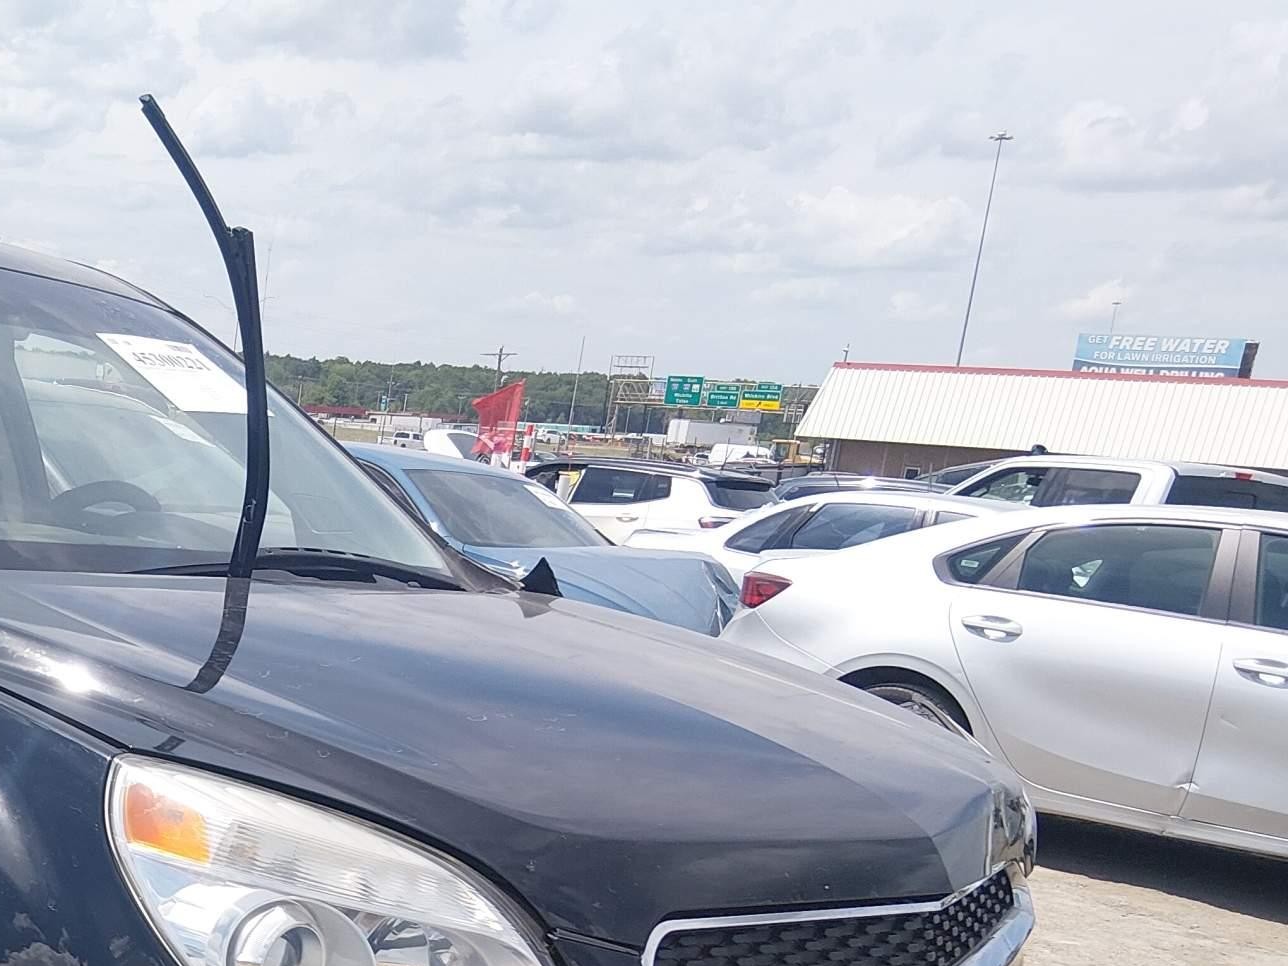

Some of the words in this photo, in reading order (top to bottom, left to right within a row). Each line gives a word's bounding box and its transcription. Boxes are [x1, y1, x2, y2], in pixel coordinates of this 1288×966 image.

[1088, 335, 1109, 344] GET
[1108, 336, 1158, 352] FREE
[1160, 338, 1229, 354] WATER
[131, 352, 211, 371] 45300221
[1093, 351, 1116, 360] FOR
[1117, 352, 1149, 362] LAWN
[1151, 354, 1217, 364] IRRIGATION
